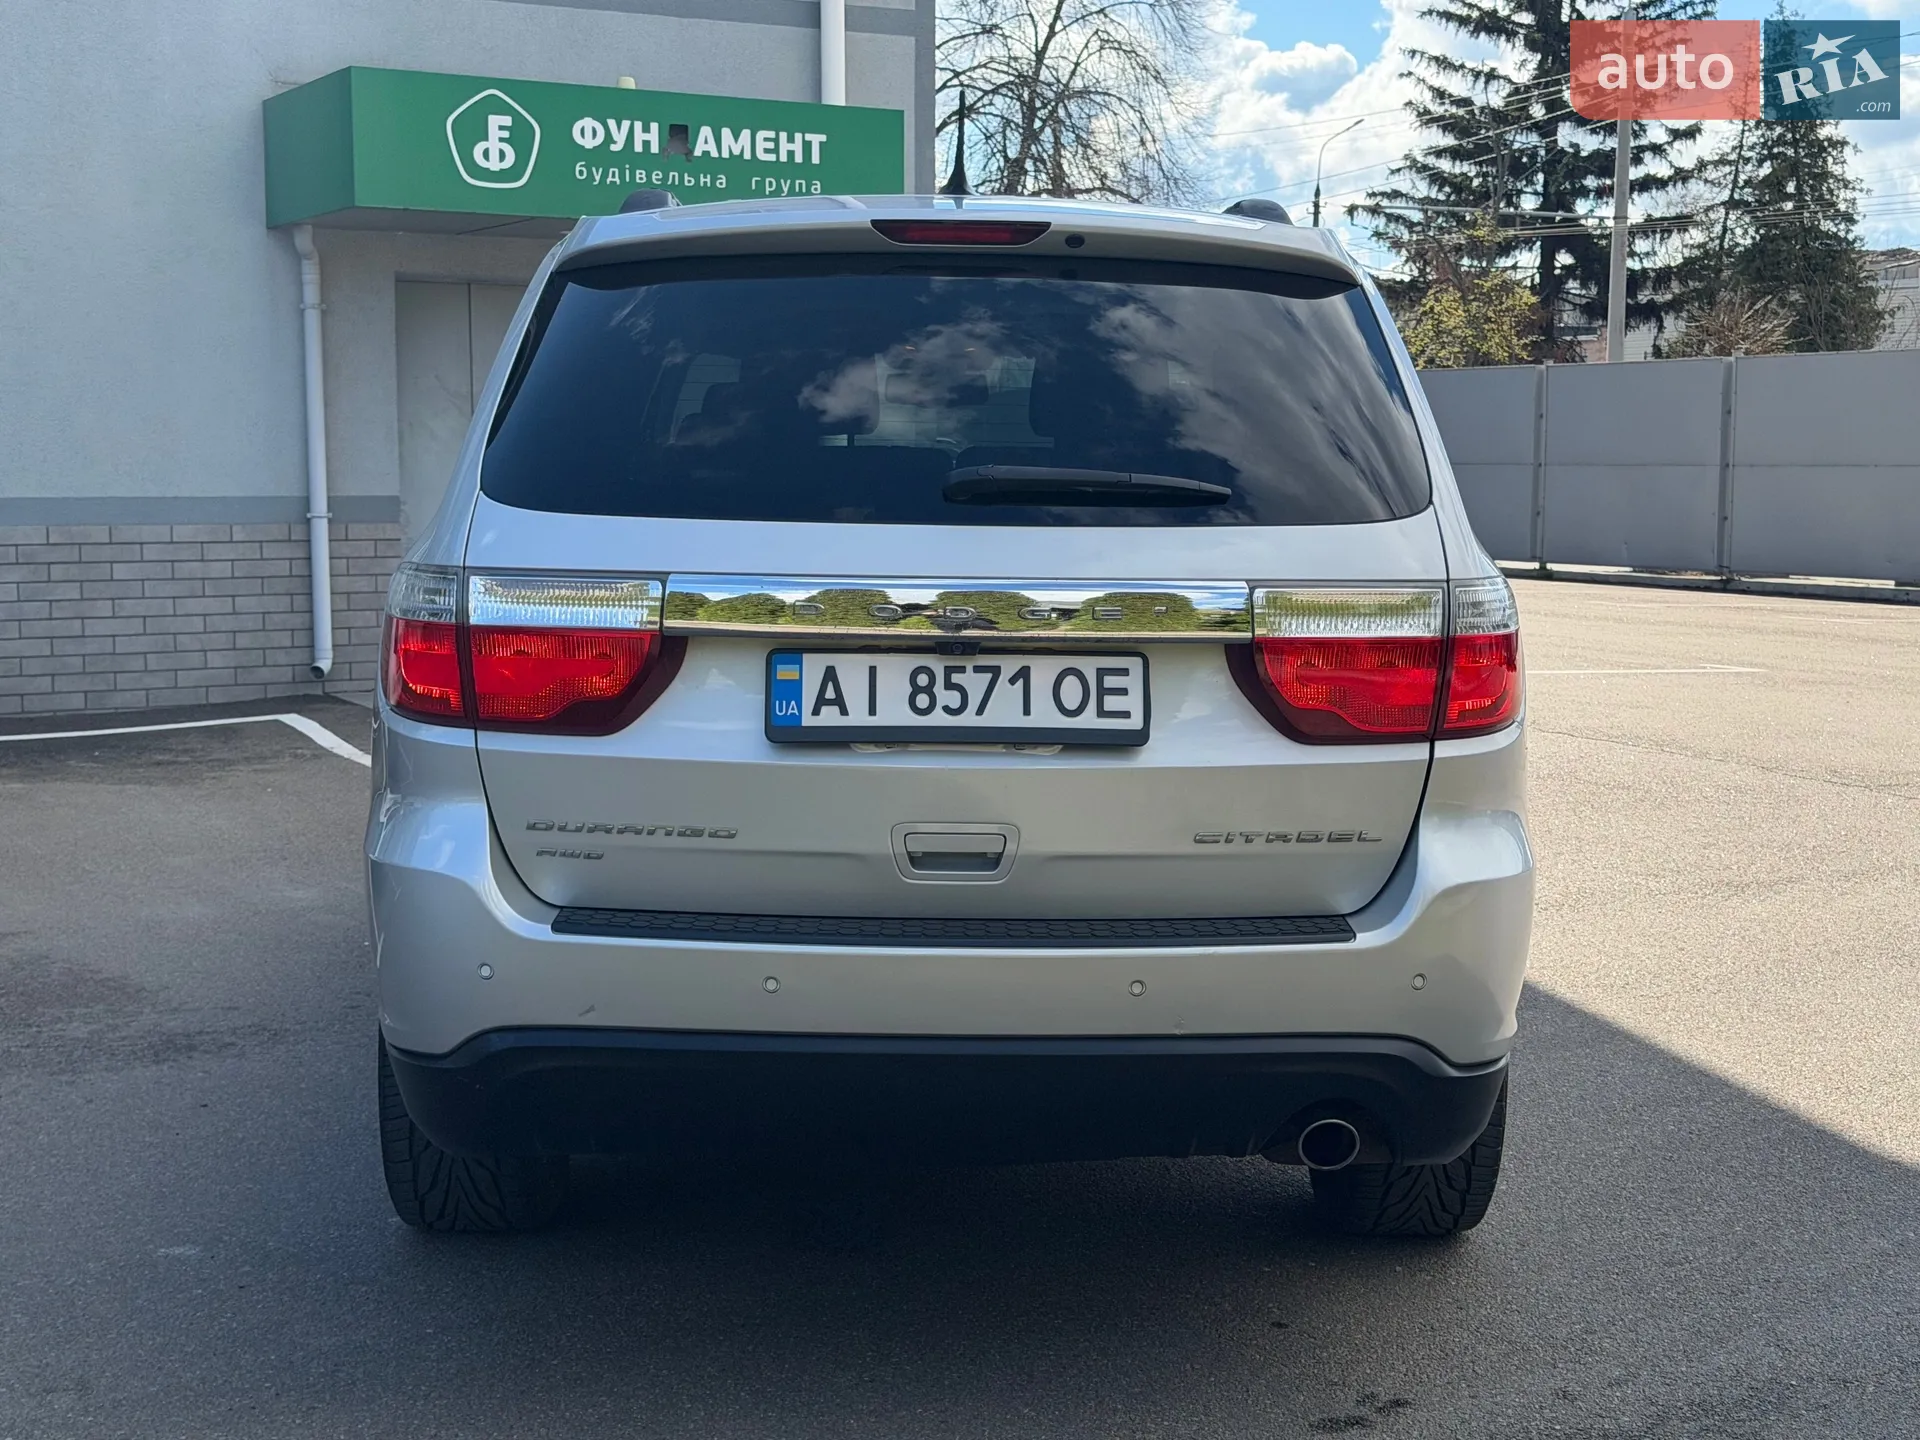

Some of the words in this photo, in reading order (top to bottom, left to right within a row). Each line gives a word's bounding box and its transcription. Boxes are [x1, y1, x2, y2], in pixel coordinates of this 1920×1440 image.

[571, 116, 828, 165] ФУНАМЕНТ
[574, 160, 728, 189] будівельна
[750, 174, 822, 195] група
[793, 599, 1123, 621] DODGE
[810, 665, 877, 717] AI
[908, 665, 1031, 717] 8571
[1052, 667, 1132, 719] OE
[775, 701, 800, 717] UA
[525, 819, 739, 840] DURANGO
[1193, 830, 1383, 844] CITADEL
[535, 848, 605, 860] AWD
